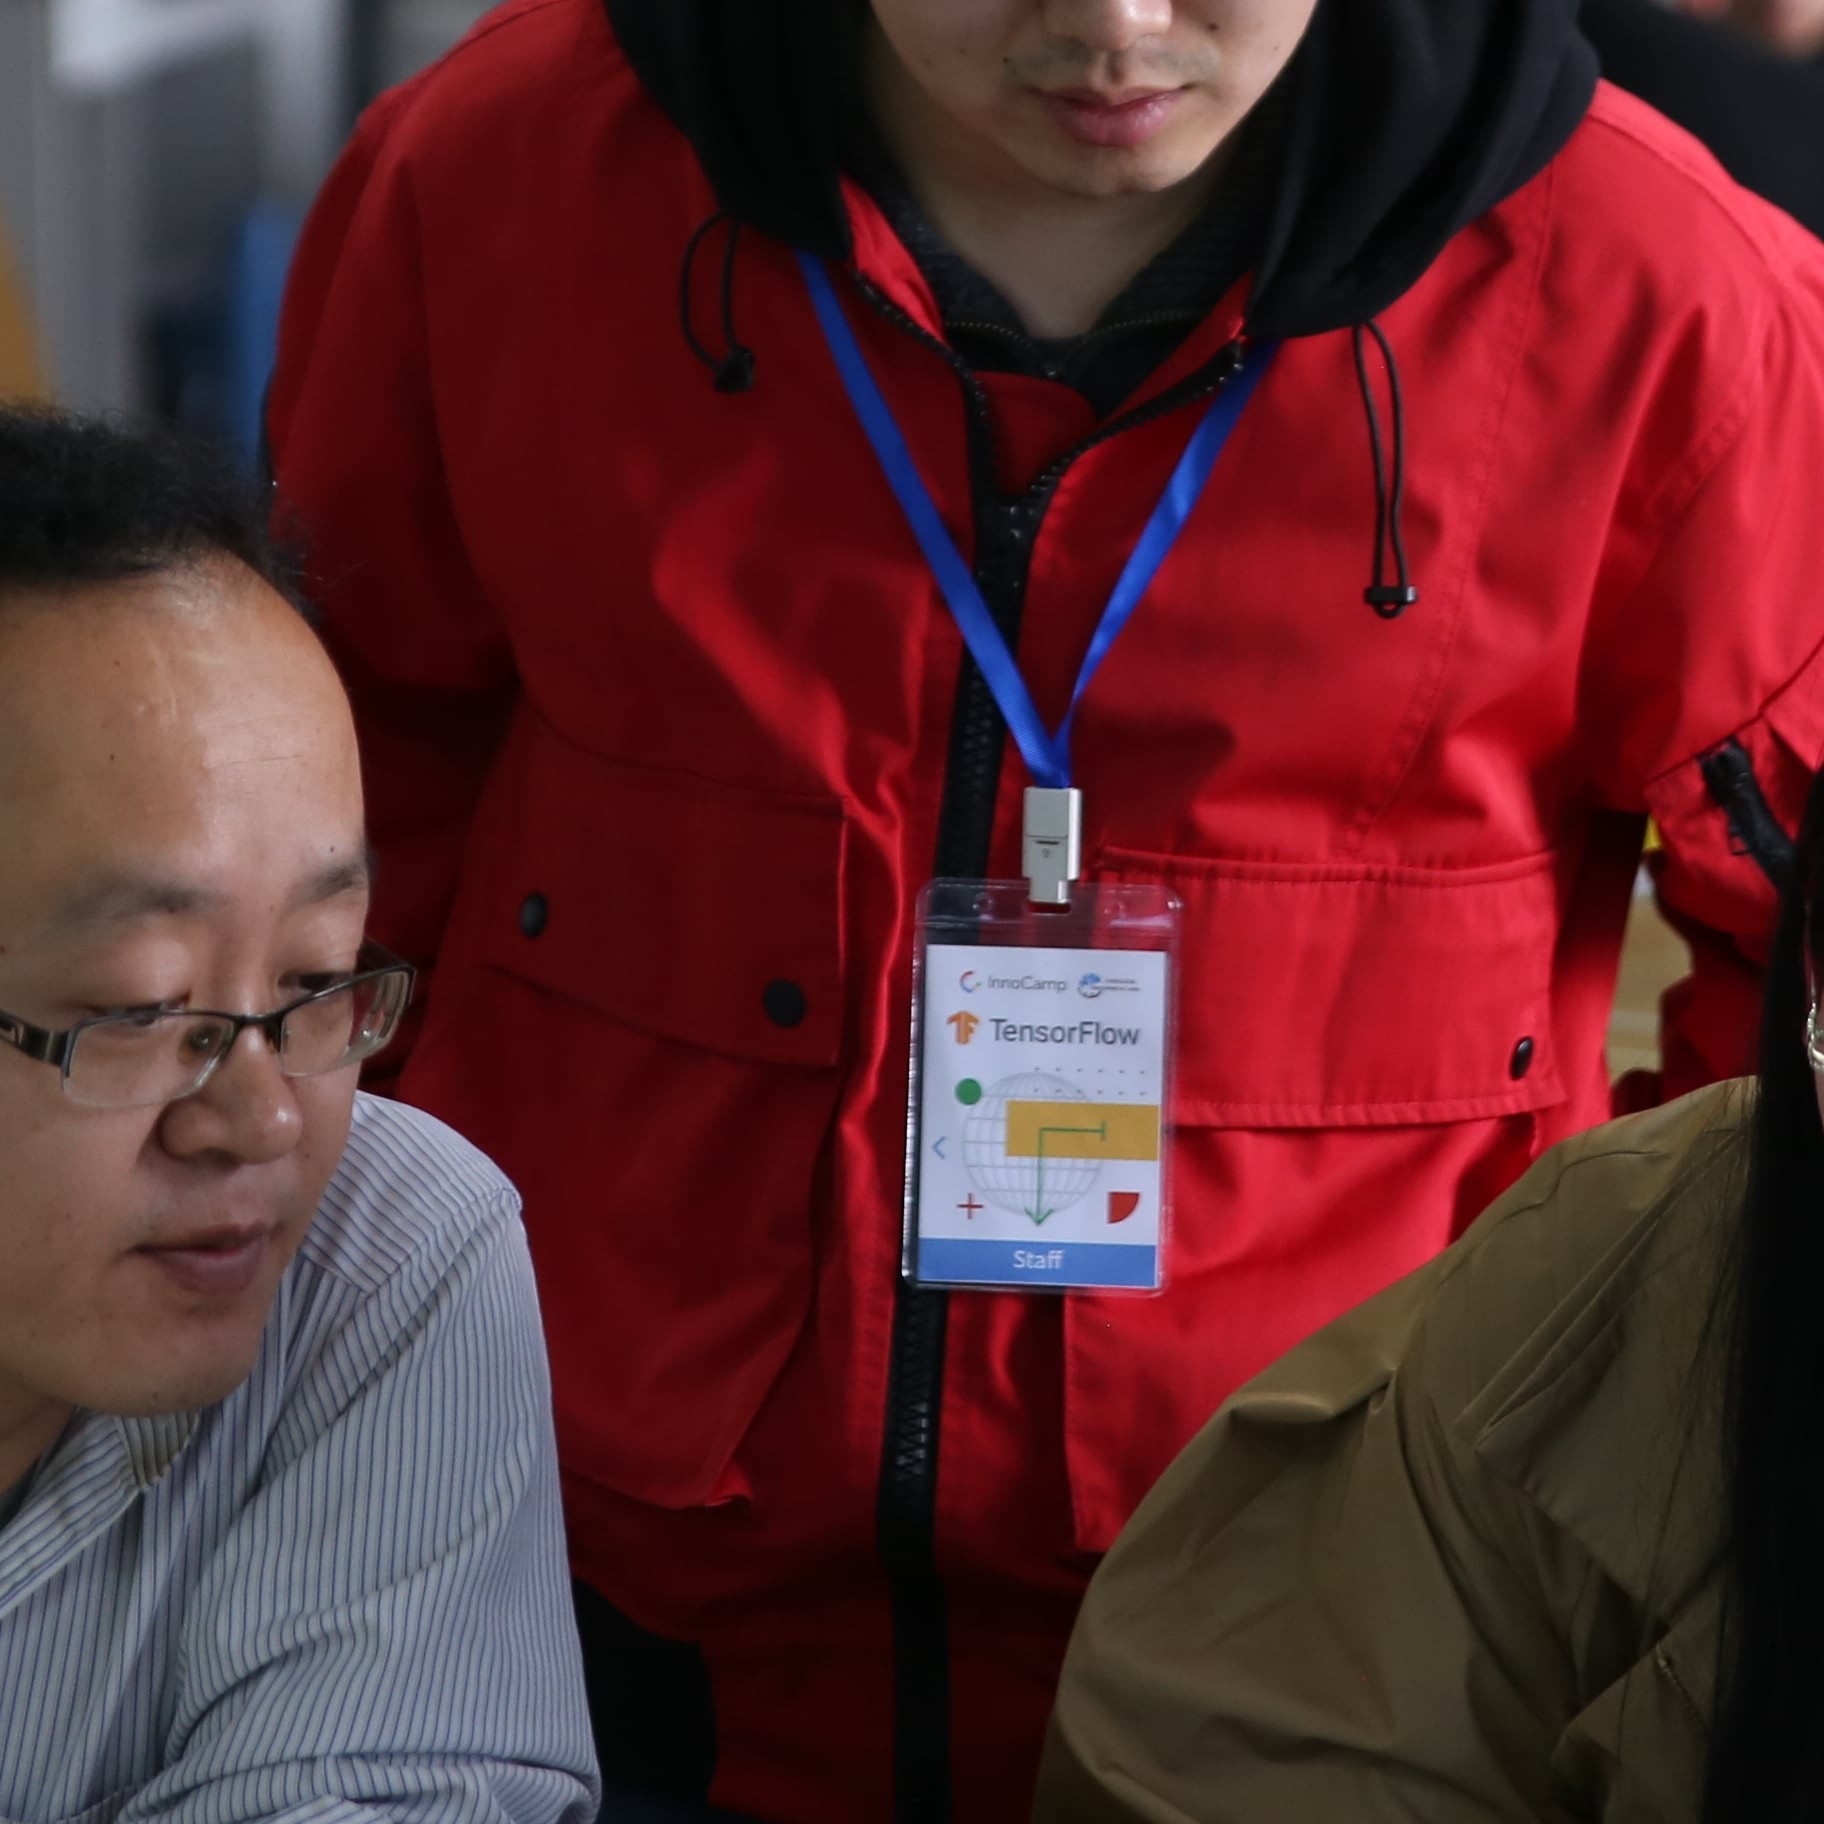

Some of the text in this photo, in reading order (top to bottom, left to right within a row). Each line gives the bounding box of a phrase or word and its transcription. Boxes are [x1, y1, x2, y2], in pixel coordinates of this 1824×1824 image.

[988, 976, 1067, 993] InnoCamp
[989, 1018, 1140, 1045] TensorFlow
[1013, 1249, 1064, 1269] Staff
